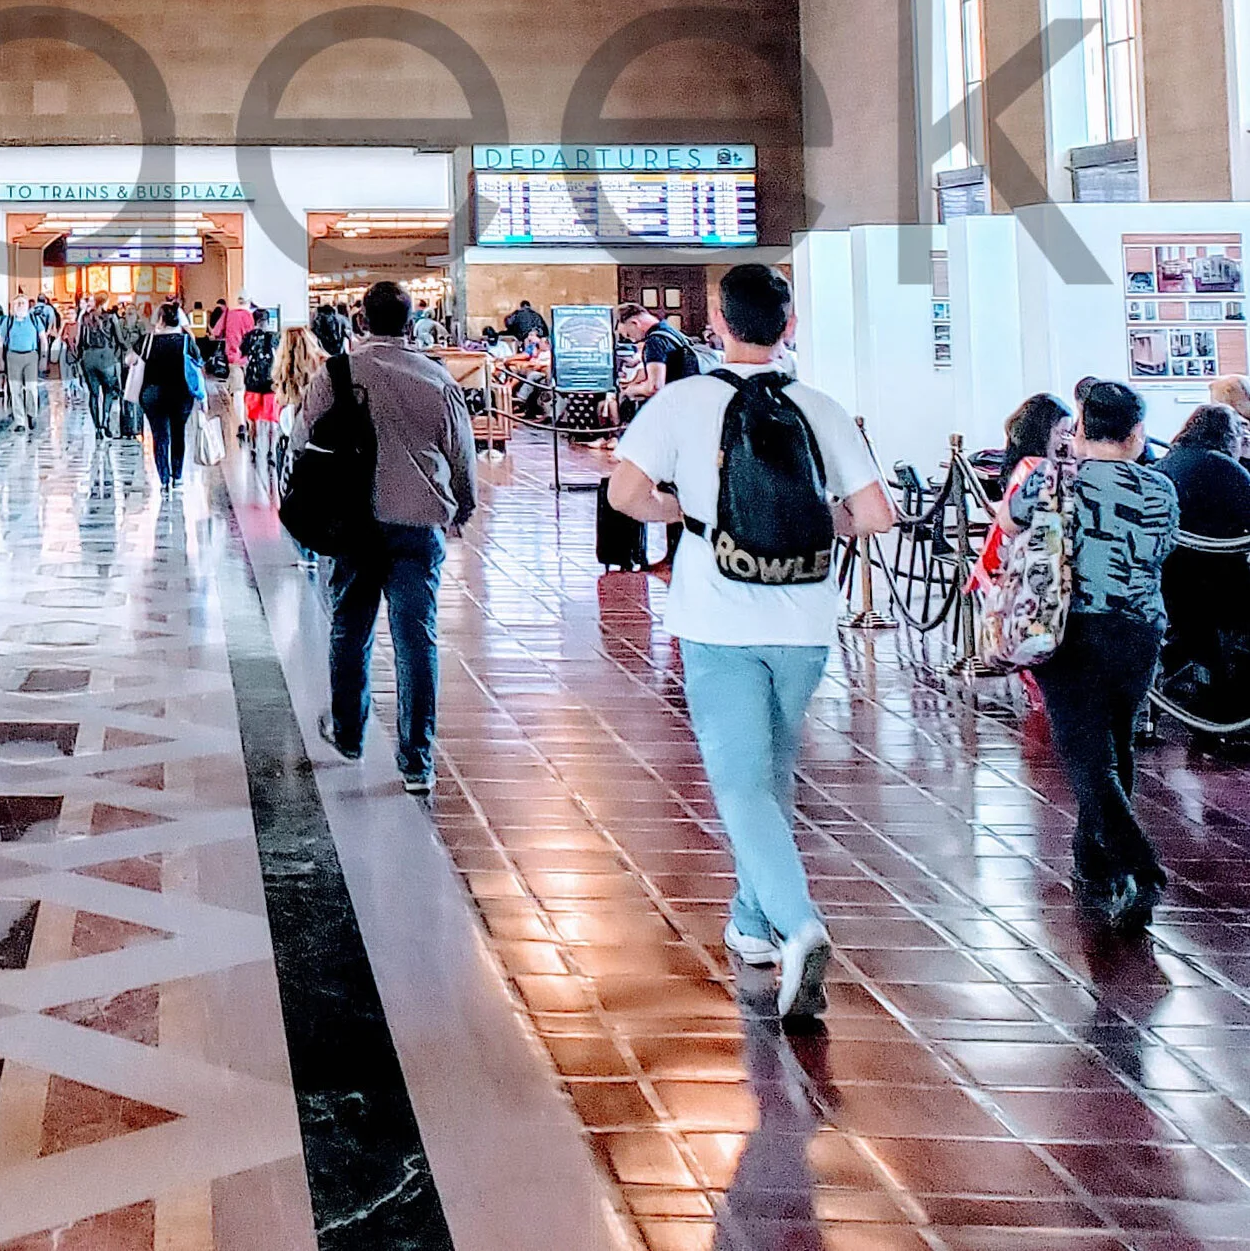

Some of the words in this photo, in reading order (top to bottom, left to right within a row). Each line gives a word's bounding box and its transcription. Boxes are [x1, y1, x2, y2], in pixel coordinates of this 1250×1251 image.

[485, 148, 702, 170] DEPARTURES
[6, 185, 32, 199] TO
[40, 185, 109, 199] TRAINS
[117, 185, 129, 199] &
[137, 185, 172, 199] BUS
[181, 185, 244, 199] PLAZA
